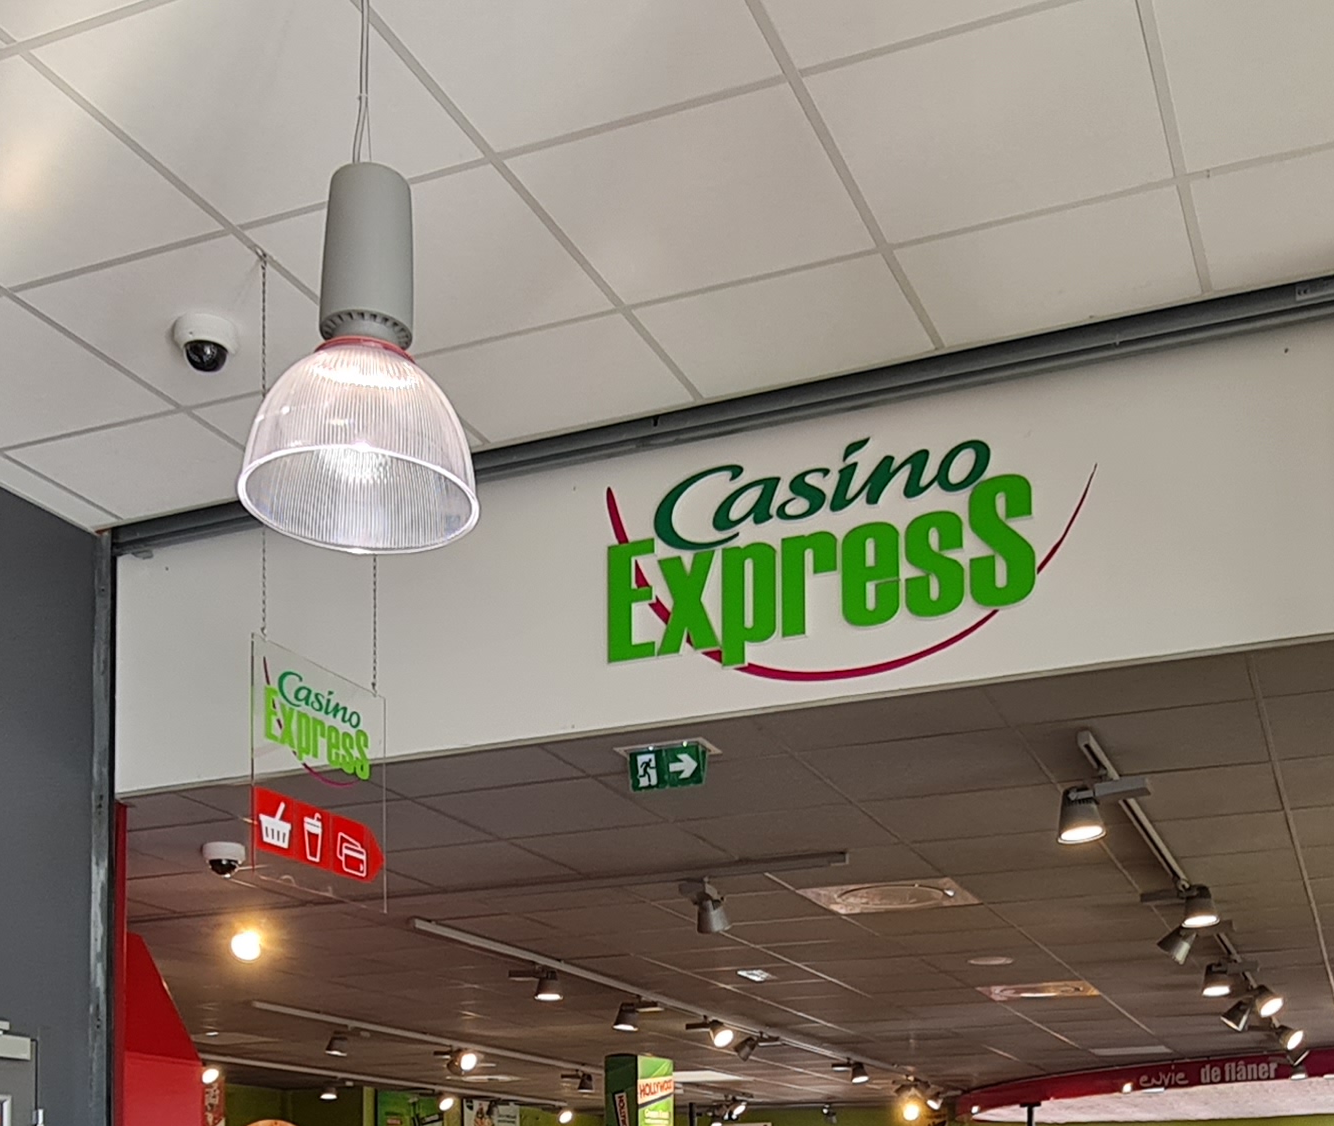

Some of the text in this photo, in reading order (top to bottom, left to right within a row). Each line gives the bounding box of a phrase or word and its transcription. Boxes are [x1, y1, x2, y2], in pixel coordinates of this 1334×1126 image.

[653, 437, 991, 552] Casino
[277, 670, 361, 729] Casino
[1138, 1060, 1278, 1089] envie de flâner
